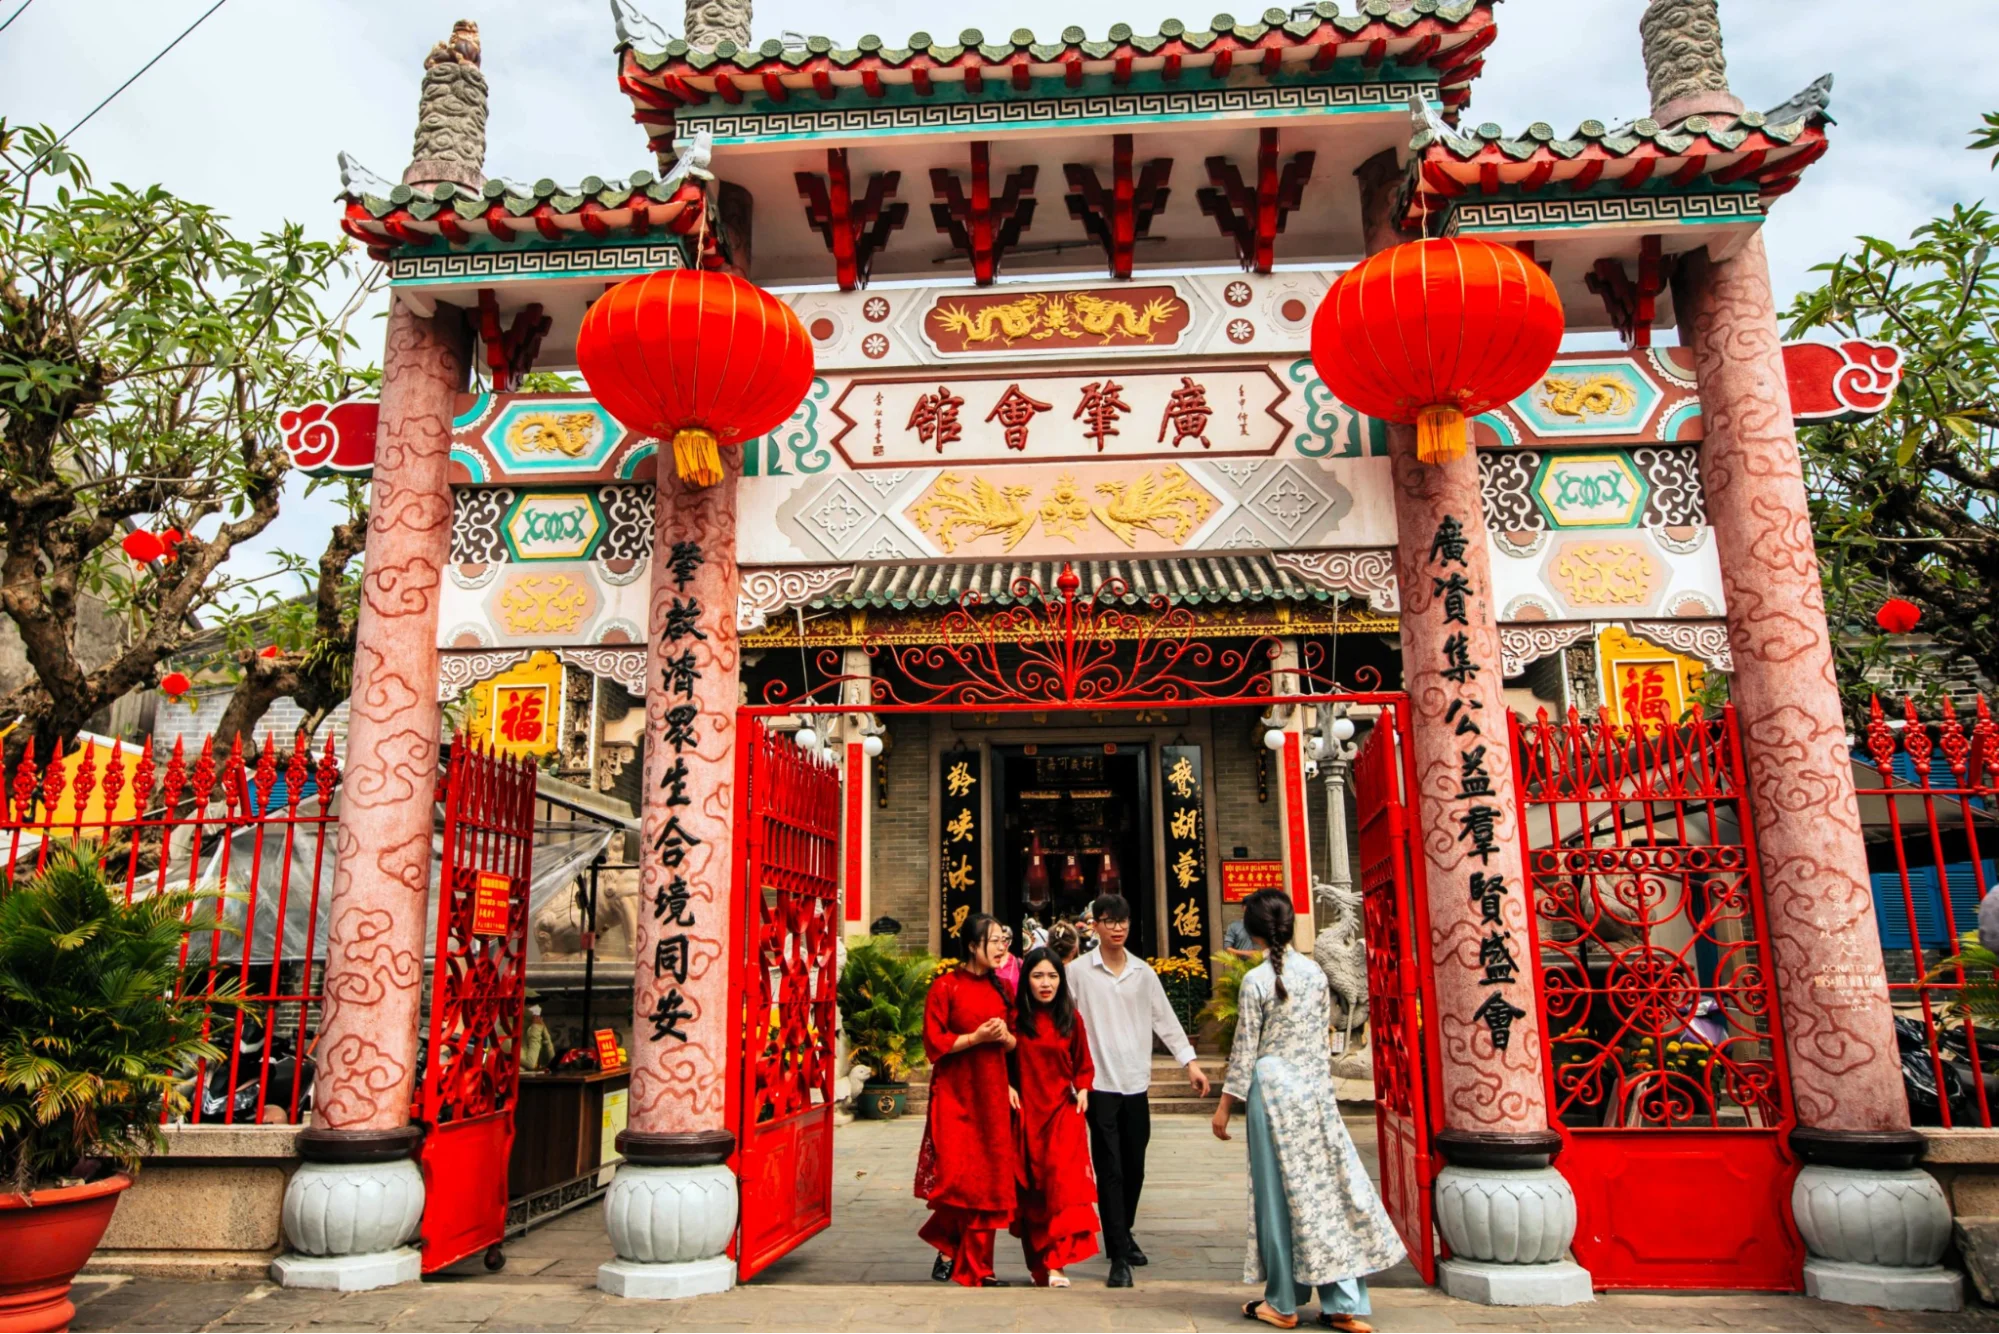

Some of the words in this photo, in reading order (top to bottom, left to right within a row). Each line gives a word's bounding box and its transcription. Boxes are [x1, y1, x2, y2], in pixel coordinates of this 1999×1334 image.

[906, 377, 1213, 454] 廣肇會館
[501, 690, 543, 742] 福
[1622, 666, 1670, 720] 福
